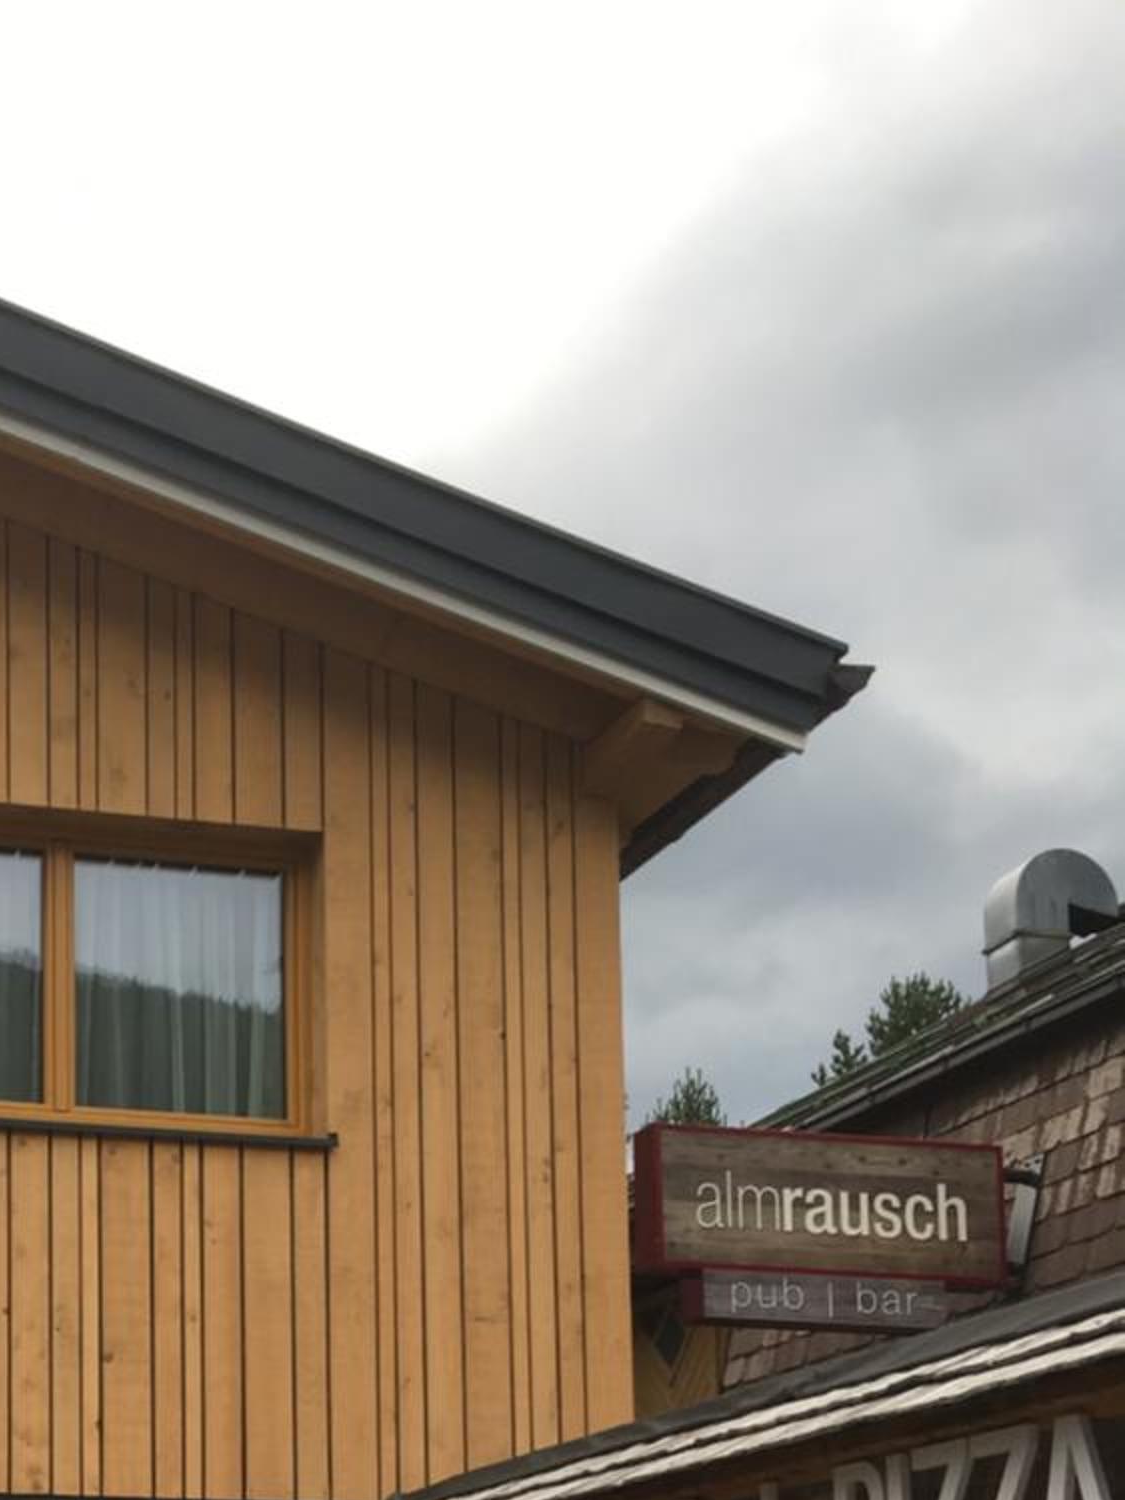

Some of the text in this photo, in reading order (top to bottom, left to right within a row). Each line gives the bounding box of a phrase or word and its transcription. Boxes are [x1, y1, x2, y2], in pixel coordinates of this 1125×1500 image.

[695, 1169, 968, 1243] almrausch
[729, 1277, 805, 1314] pub
[856, 1279, 918, 1317] bar
